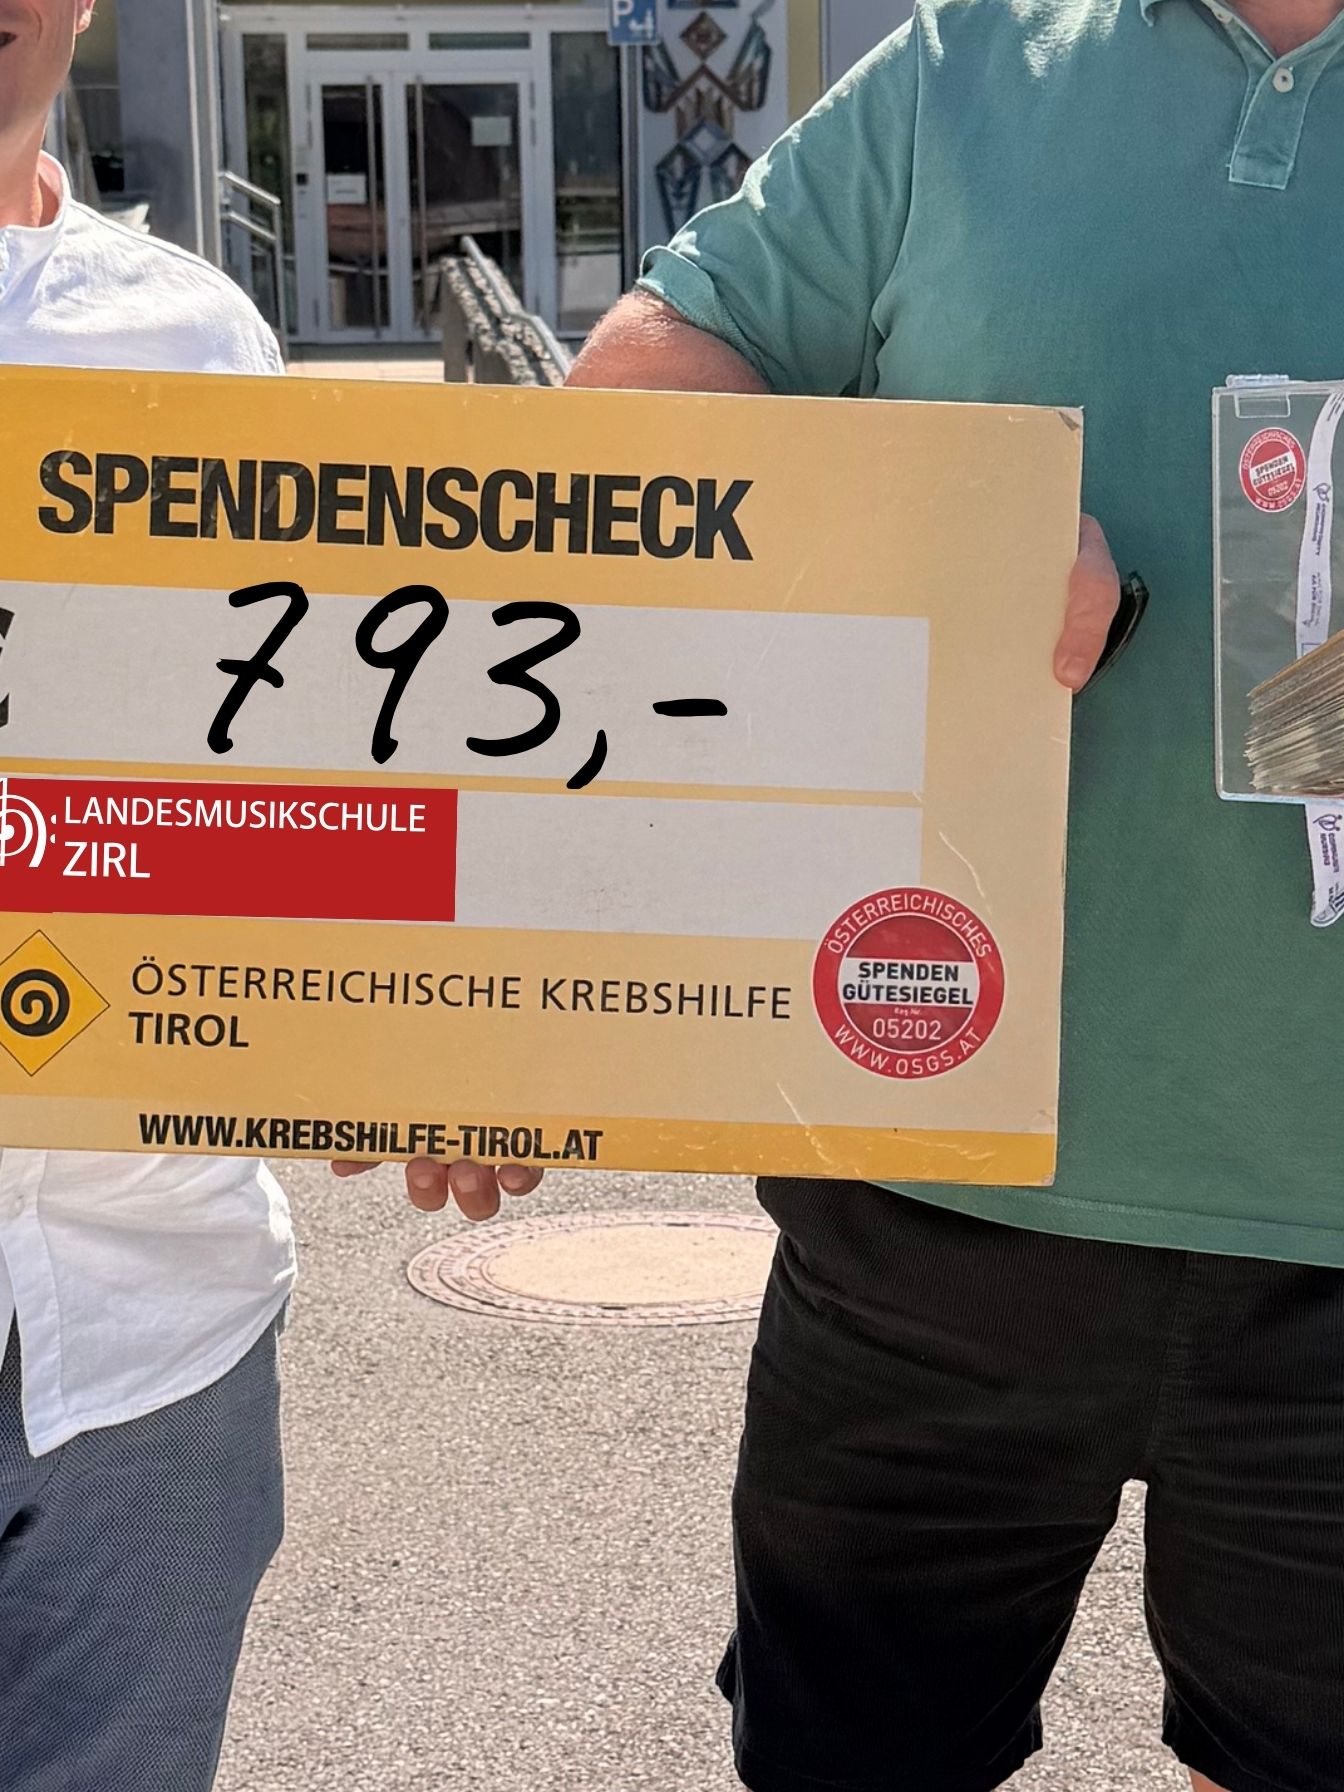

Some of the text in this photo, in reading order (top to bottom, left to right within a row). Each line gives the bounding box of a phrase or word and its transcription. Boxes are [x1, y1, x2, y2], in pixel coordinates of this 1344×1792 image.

[38, 450, 755, 561] SPENDENSCHECK
[207, 581, 728, 790] 793,-
[64, 796, 426, 833] LANDESMUSIKSCHULE
[62, 841, 151, 879] ZIRL
[823, 892, 993, 958] ÖSTERREICHISCHES
[131, 955, 792, 1019] ÖSTERREICHISCHE KREBSHILFE
[842, 979, 974, 1005] GÜTESIEGEL
[858, 961, 959, 982] SPENDEN
[128, 1011, 250, 1048] TIROL
[834, 1024, 982, 1075] WWW.OSGS.AT
[872, 1018, 942, 1041] 05202
[138, 1113, 604, 1161] WWW.KREBSHILFE-TIROL.AT
